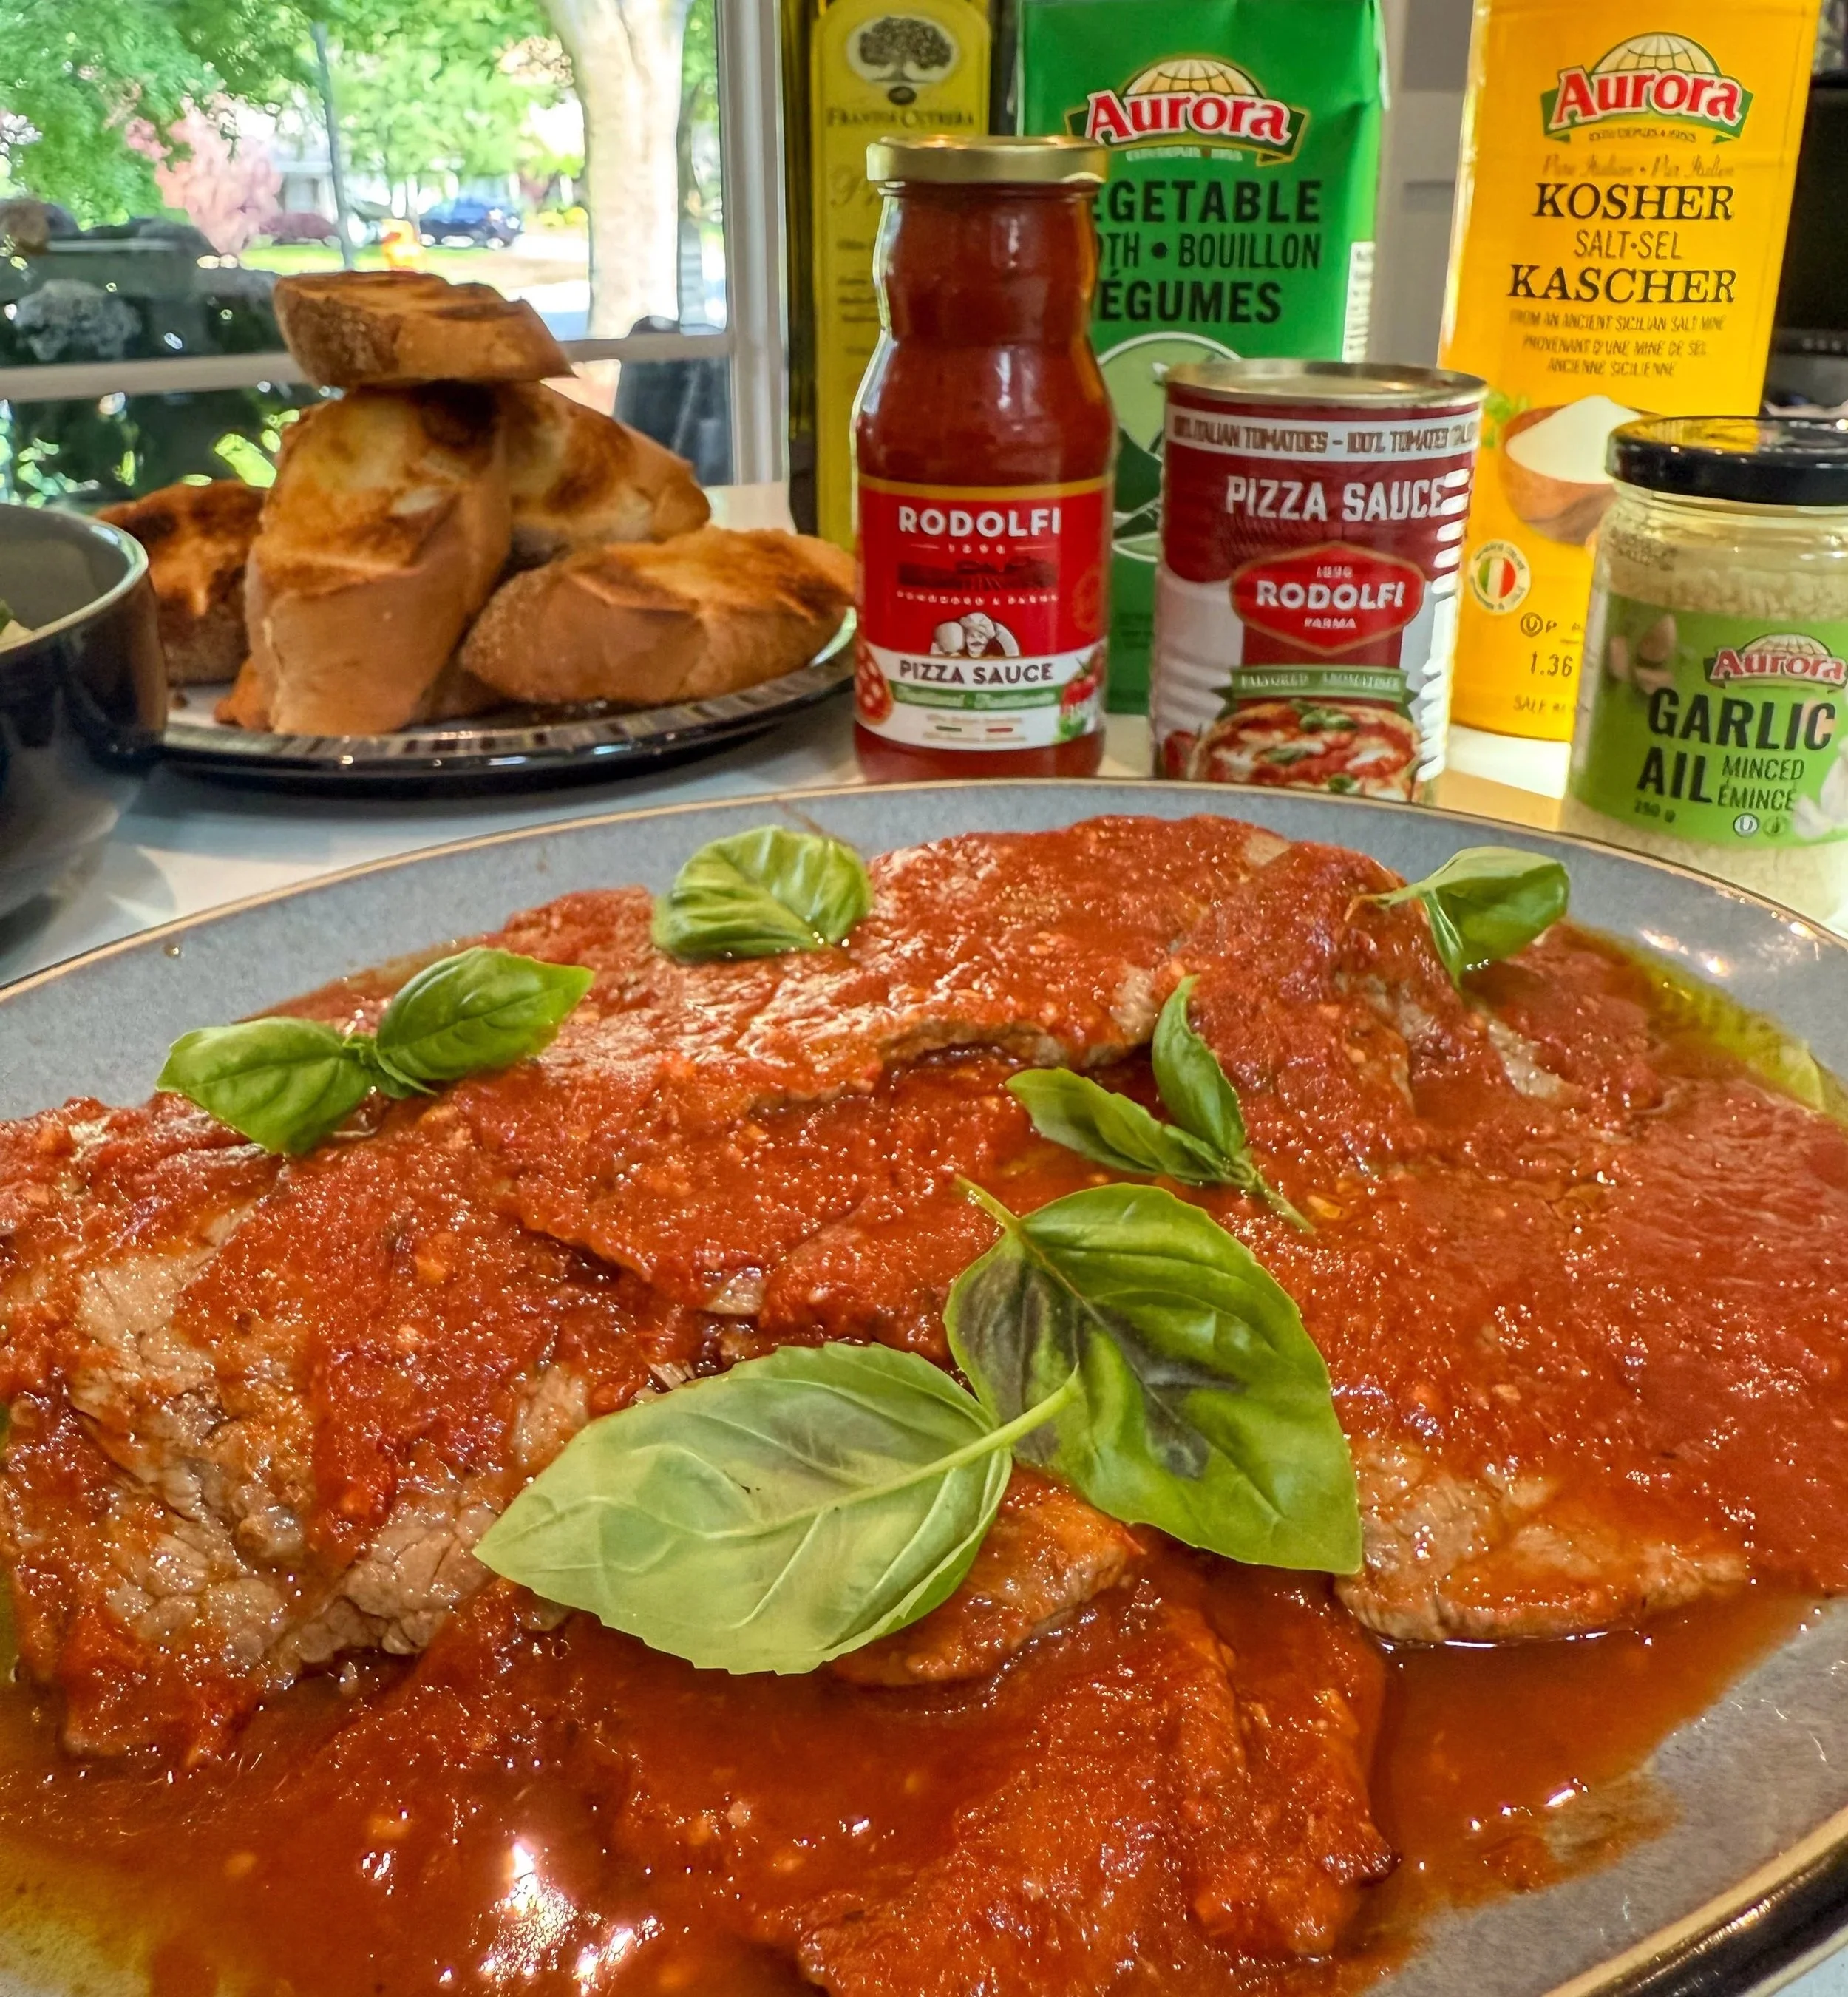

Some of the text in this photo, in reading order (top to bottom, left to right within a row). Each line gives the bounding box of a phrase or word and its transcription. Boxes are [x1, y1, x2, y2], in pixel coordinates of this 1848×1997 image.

[1555, 71, 1742, 123] Aurora
[1088, 92, 1288, 143] Aurora
[1532, 182, 1736, 221] KOSHER
[1178, 231, 1322, 270] BOUILLON
[1507, 263, 1737, 304] KASCHER
[1561, 313, 1611, 330] ANCIENT
[1225, 475, 1447, 523] PIZZA SAUCE
[897, 506, 1062, 538] RODOLFI
[1256, 580, 1404, 611] RODOLFI
[898, 659, 1053, 685] PIZZA SAUCE
[1529, 650, 1574, 677] 1.36
[1711, 648, 1845, 681] Aurora
[1648, 686, 1836, 751] GARLIC
[1636, 746, 1713, 804] AIL
[1721, 754, 1805, 781] MINCED
